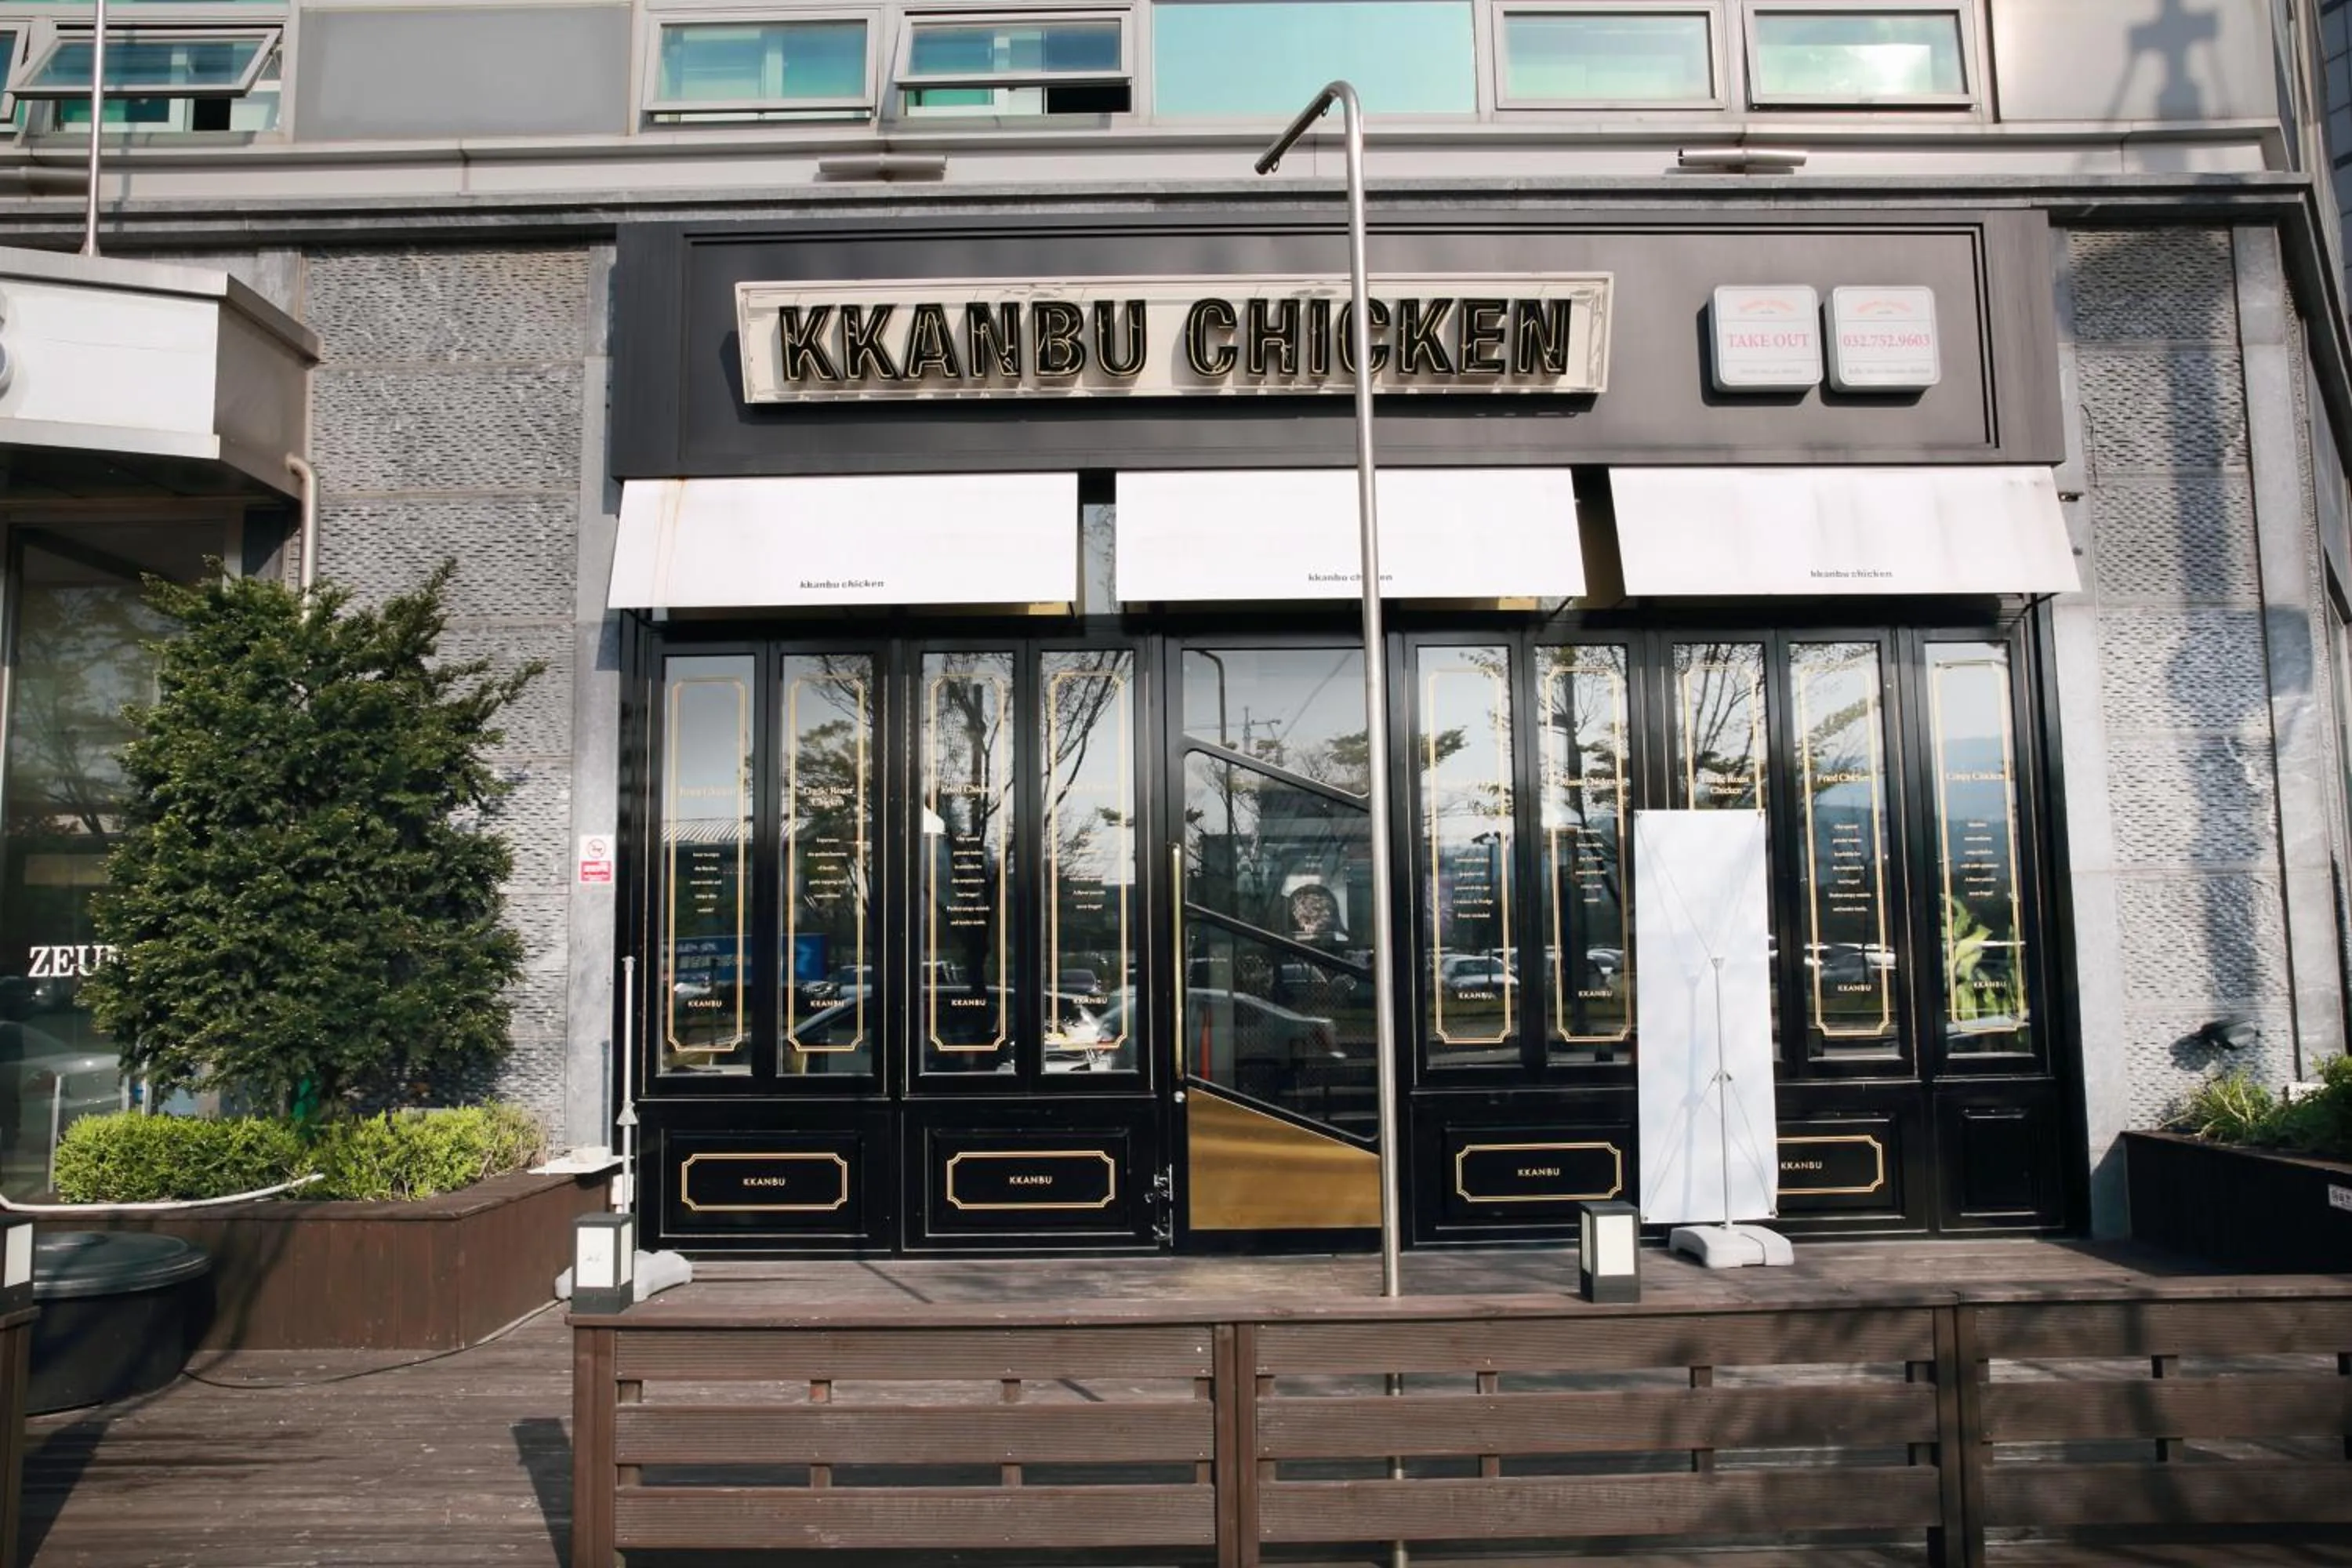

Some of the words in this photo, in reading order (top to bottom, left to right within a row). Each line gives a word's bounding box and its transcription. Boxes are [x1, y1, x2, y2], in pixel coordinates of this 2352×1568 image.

[782, 299, 1146, 381] KKANBU
[1185, 297, 1570, 378] CHICKEN
[1727, 334, 1769, 347] TAKE
[1773, 334, 1809, 347] OUT
[1843, 333, 1930, 347] 032.752.9603
[1810, 569, 1849, 578] kkanbu
[1851, 568, 1893, 578] chicken
[800, 579, 840, 588] kkanbu
[842, 579, 884, 588] chicken
[28, 945, 118, 978] ZEU
[688, 1000, 722, 1008] KKANBU
[810, 1000, 844, 1008] KKANBU
[1780, 1161, 1823, 1170] KKANBU
[1518, 1167, 1560, 1177] KKANBU
[742, 1178, 786, 1186] KKANBU
[1009, 1176, 1052, 1185] KKANBU
